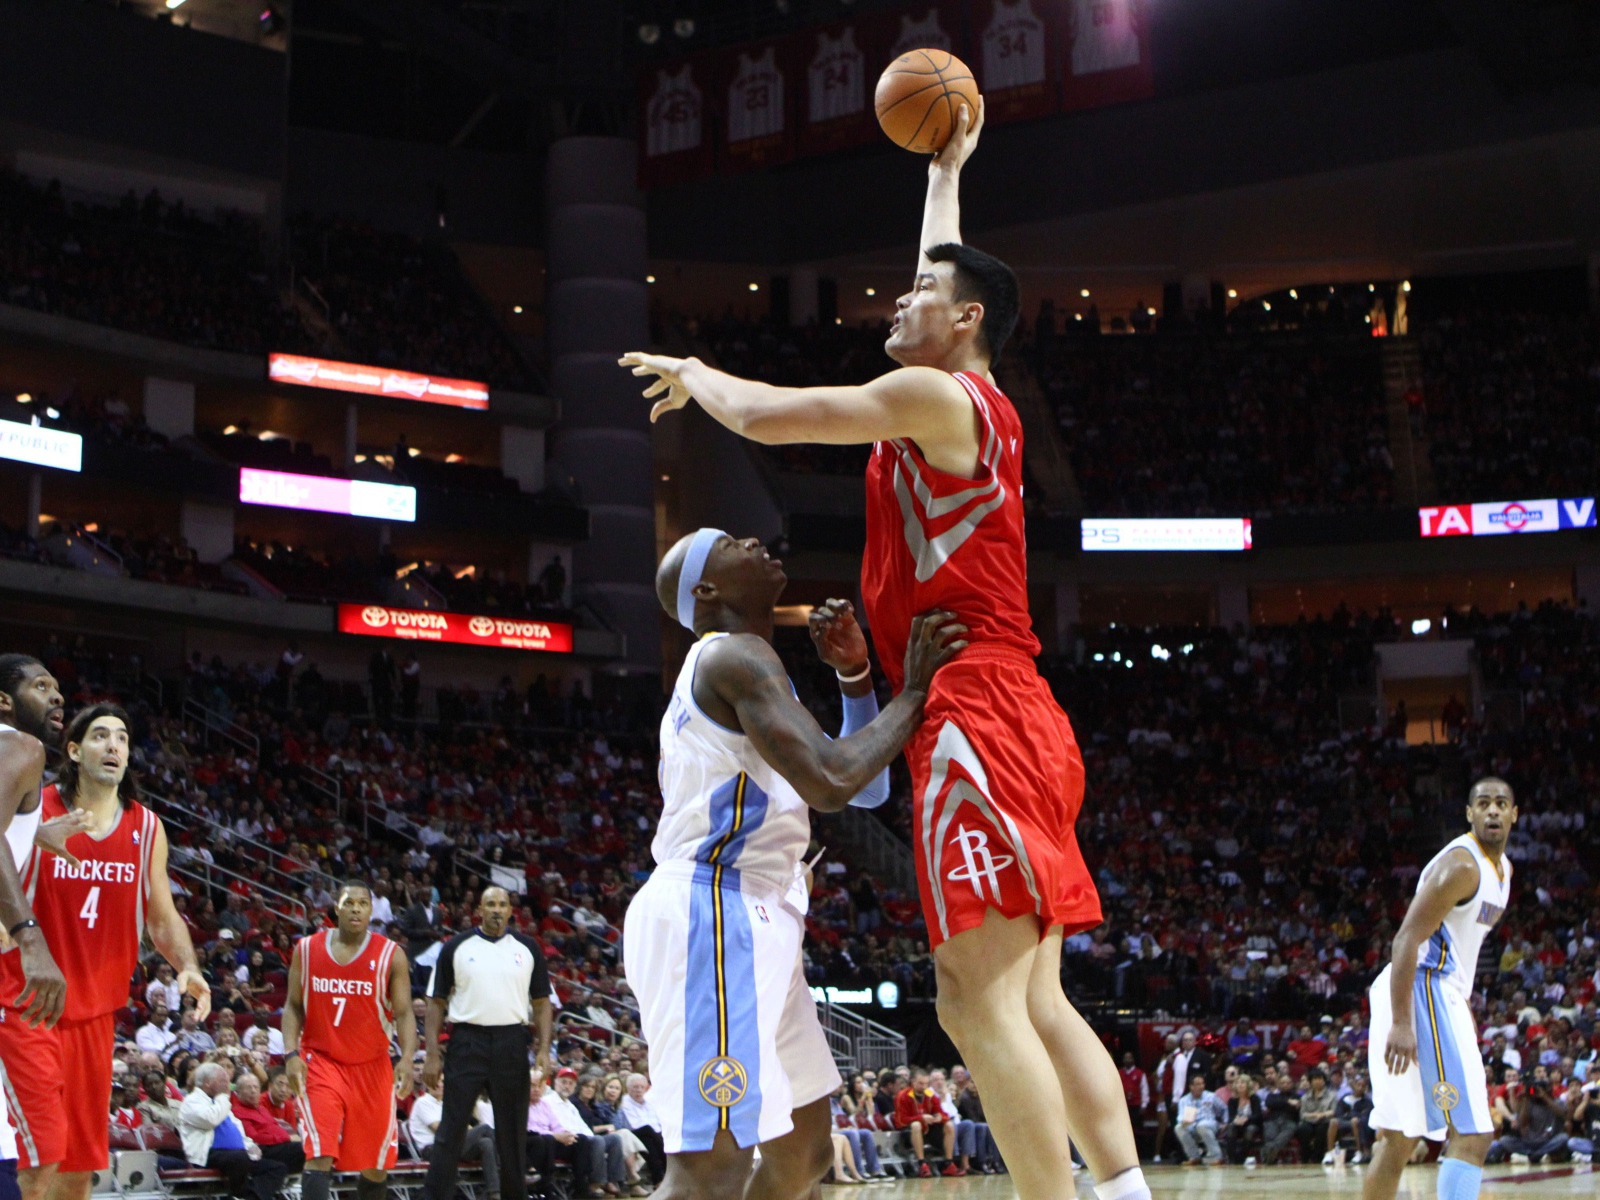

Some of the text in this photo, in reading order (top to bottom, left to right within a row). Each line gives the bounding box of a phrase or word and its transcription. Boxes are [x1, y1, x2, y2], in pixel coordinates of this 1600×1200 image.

[999, 32, 1027, 58] 34
[1419, 507, 1470, 536] TA
[390, 611, 448, 630] TOYOTA
[496, 620, 551, 639] TOYOTA
[52, 855, 136, 883] ROCKETS
[80, 886, 101, 929] 4
[312, 976, 373, 996] ROCKETS
[333, 997, 347, 1027] 7
